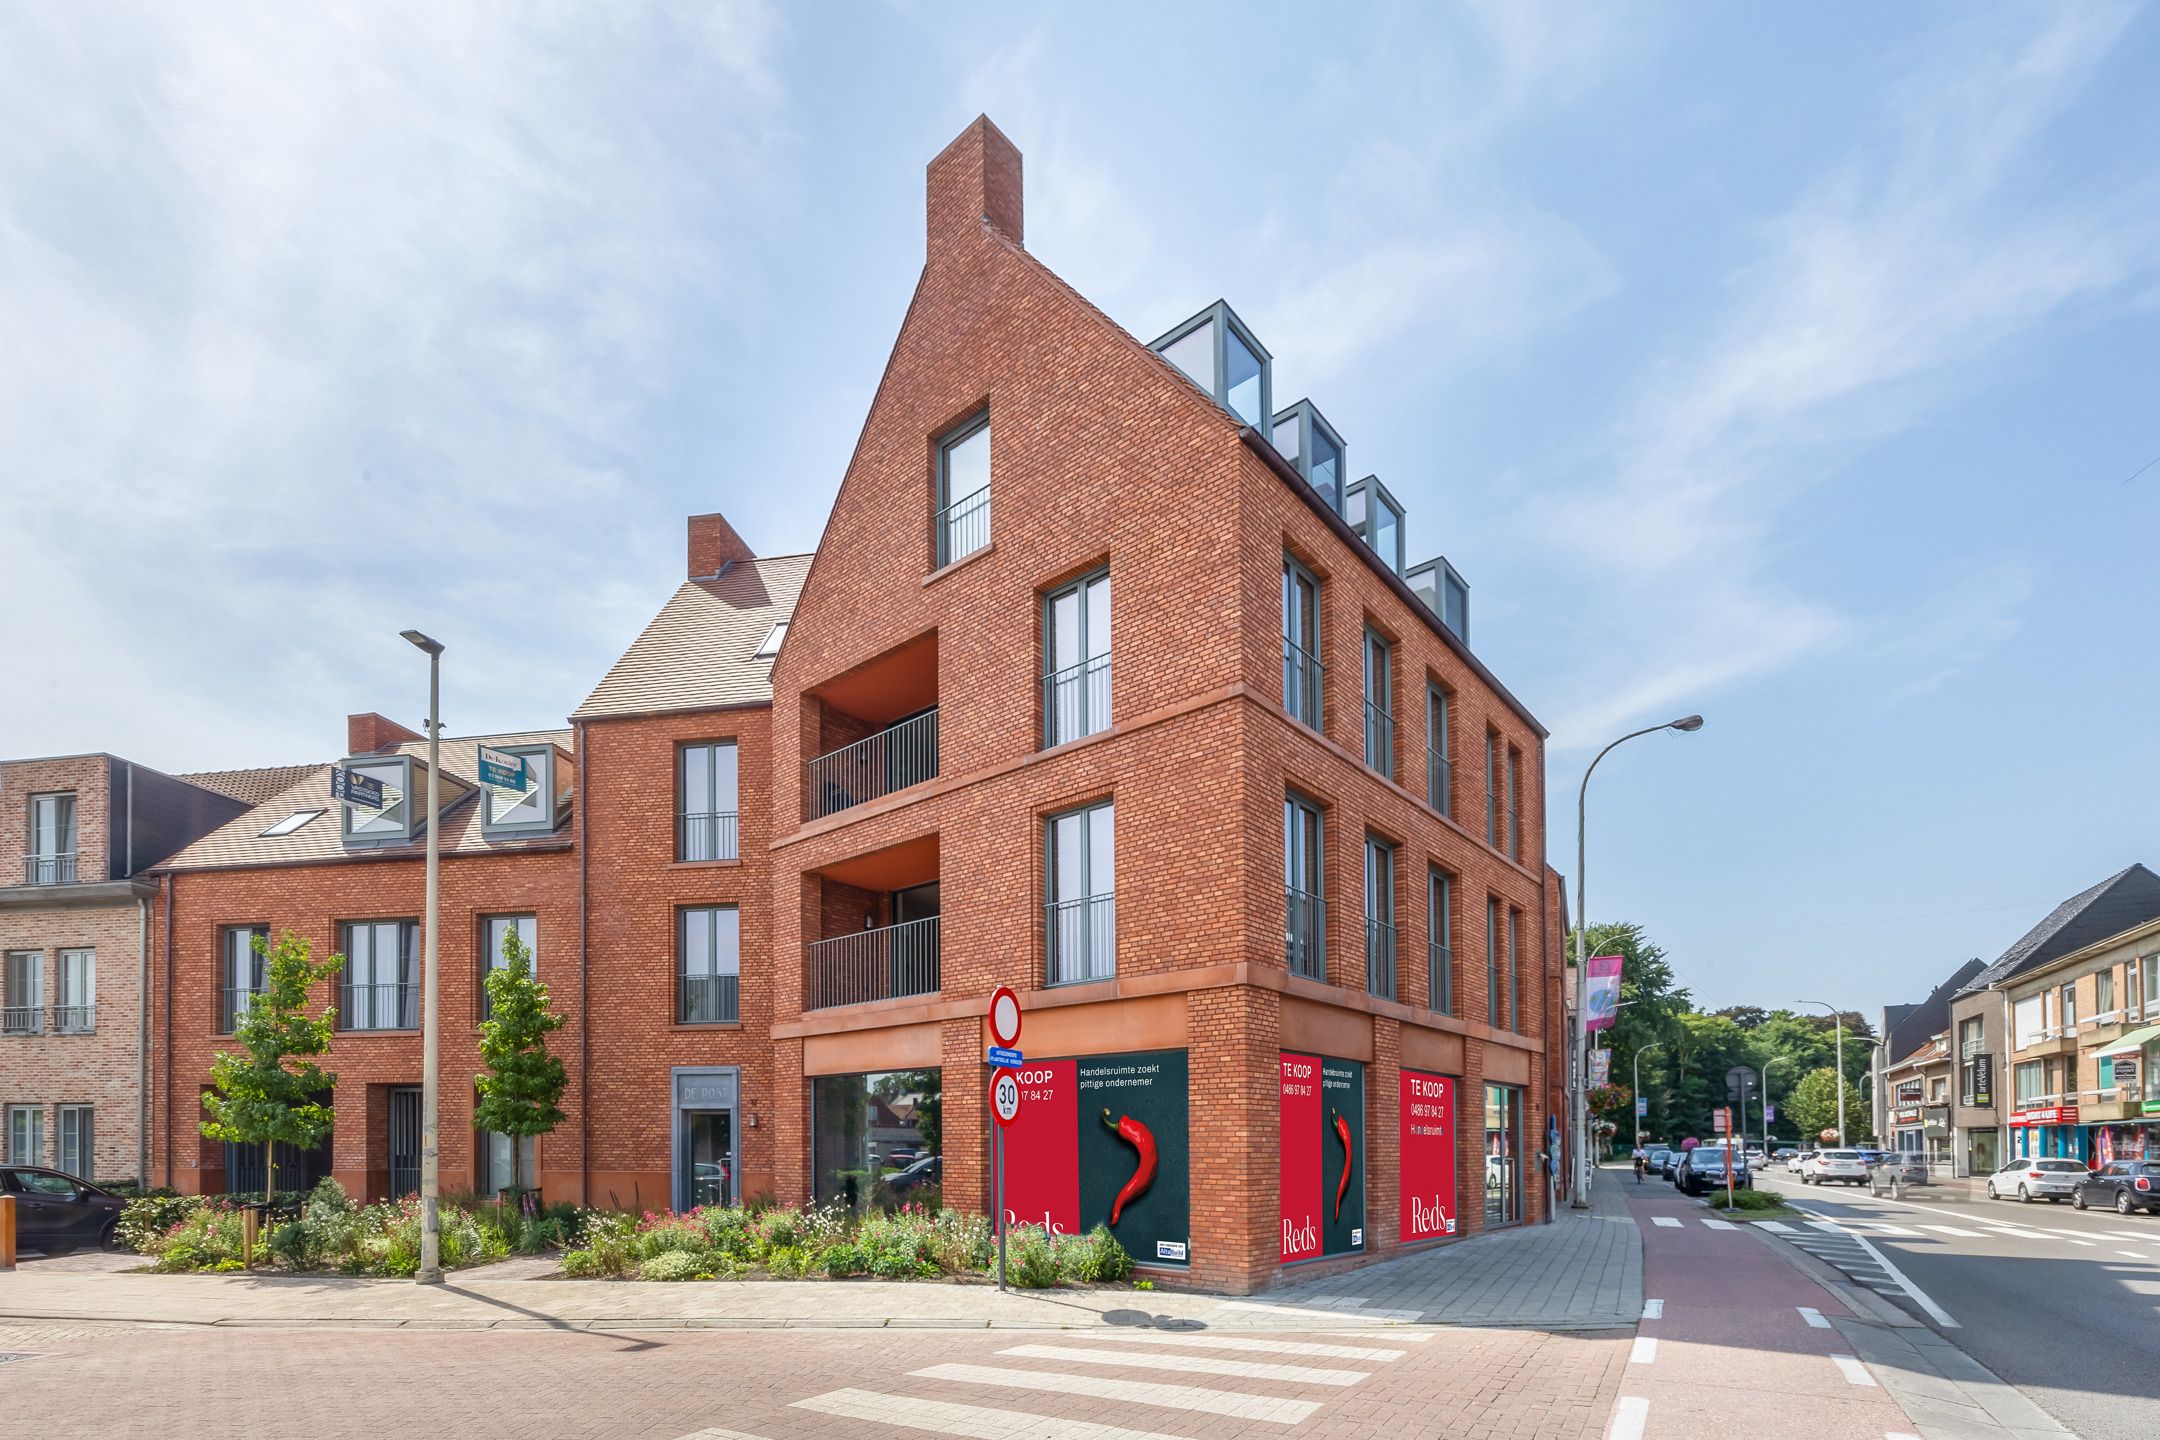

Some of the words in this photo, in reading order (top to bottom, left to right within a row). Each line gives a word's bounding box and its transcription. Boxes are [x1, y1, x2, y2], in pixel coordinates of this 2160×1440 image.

[1016, 1070, 1053, 1084] KOOP
[1080, 1065, 1135, 1077] Handelsruimte
[1137, 1063, 1160, 1074] zoekt
[1283, 1062, 1291, 1077] TE
[1293, 1063, 1312, 1079] KOOP
[1080, 1079, 1104, 1090] pittige
[1105, 1078, 1153, 1087] ondernemer
[1411, 1079, 1421, 1096] TE
[1422, 1080, 1444, 1098] KOOP
[684, 1087, 697, 1099] DE
[999, 1084, 1015, 1105] 30
[1030, 1090, 1041, 1101] 84
[1042, 1089, 1054, 1101] 27
[1411, 1194, 1446, 1234] Reds
[1283, 1215, 1316, 1255] Reds
